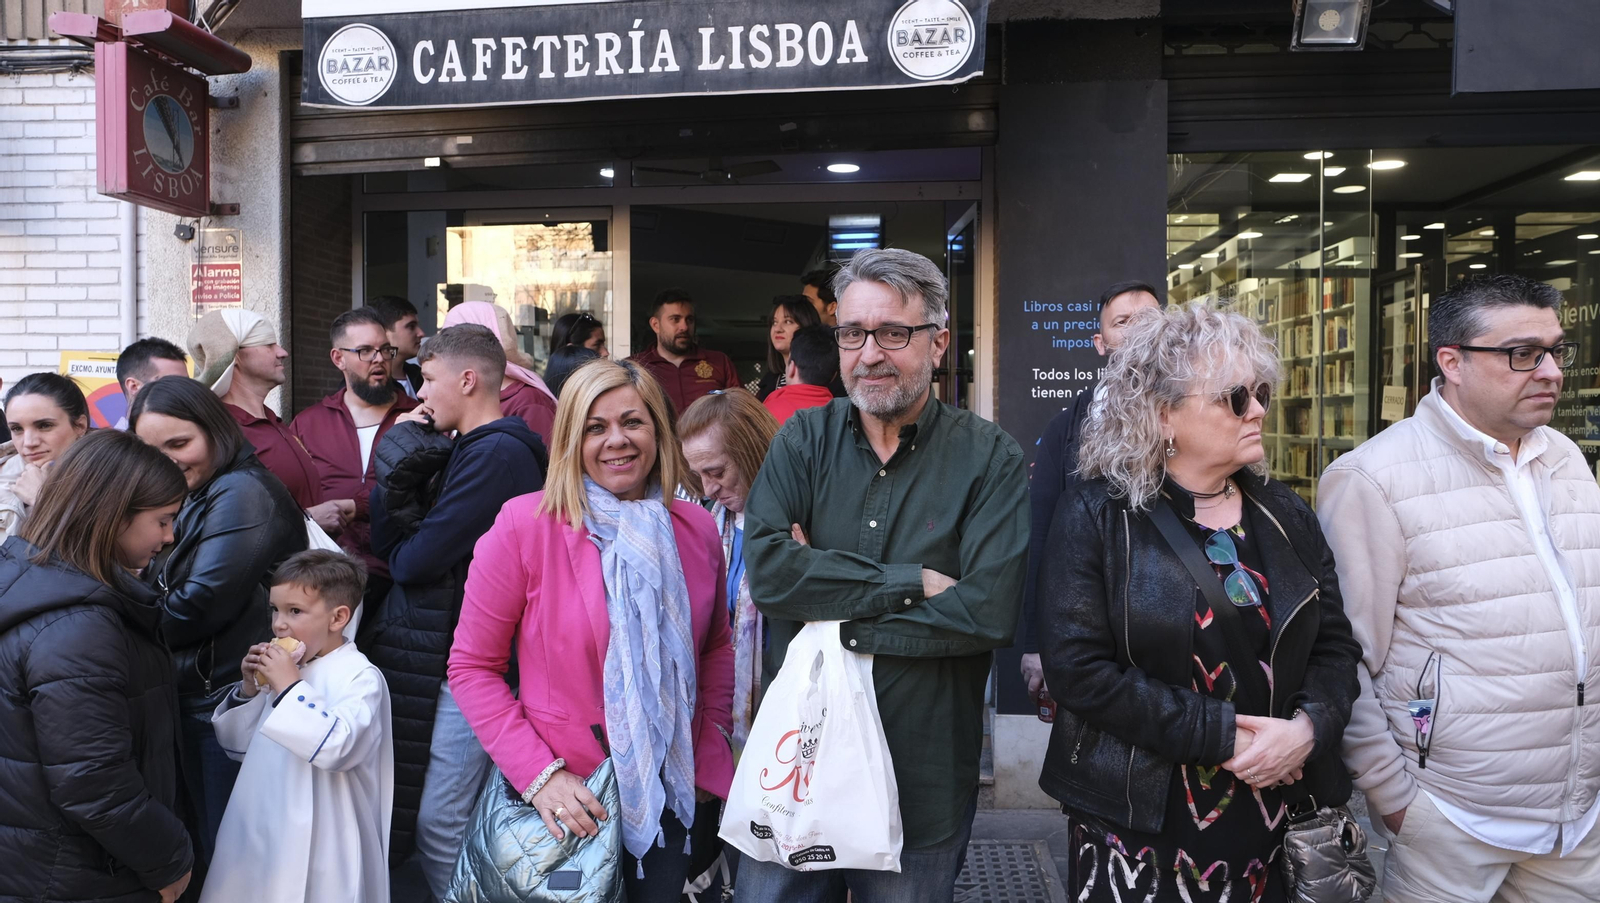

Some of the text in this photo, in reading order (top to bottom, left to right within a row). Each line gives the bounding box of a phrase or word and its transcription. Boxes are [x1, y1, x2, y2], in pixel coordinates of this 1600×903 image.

[896, 27, 967, 47] BAZAR
[412, 18, 869, 84] CAFETERÍA LISBOA
[326, 55, 391, 74] BAZAR
[129, 67, 202, 136] Café Bar
[132, 146, 204, 199] LISBOA
[193, 245, 239, 254] verisure
[193, 266, 240, 278] Alarma
[1024, 300, 1063, 312] Libros
[1067, 300, 1092, 312] casi
[1560, 300, 1600, 325] ienv
[1031, 321, 1039, 330] a
[1043, 321, 1059, 330] un
[71, 364, 94, 373] EXCMO.
[1032, 368, 1070, 380] Todos
[1074, 368, 1093, 380] los
[1561, 366, 1579, 378] drás
[1031, 386, 1072, 398] tienen
[1558, 404, 1588, 416] también
[1568, 424, 1599, 438] siempre
[794, 856, 806, 864] 950
